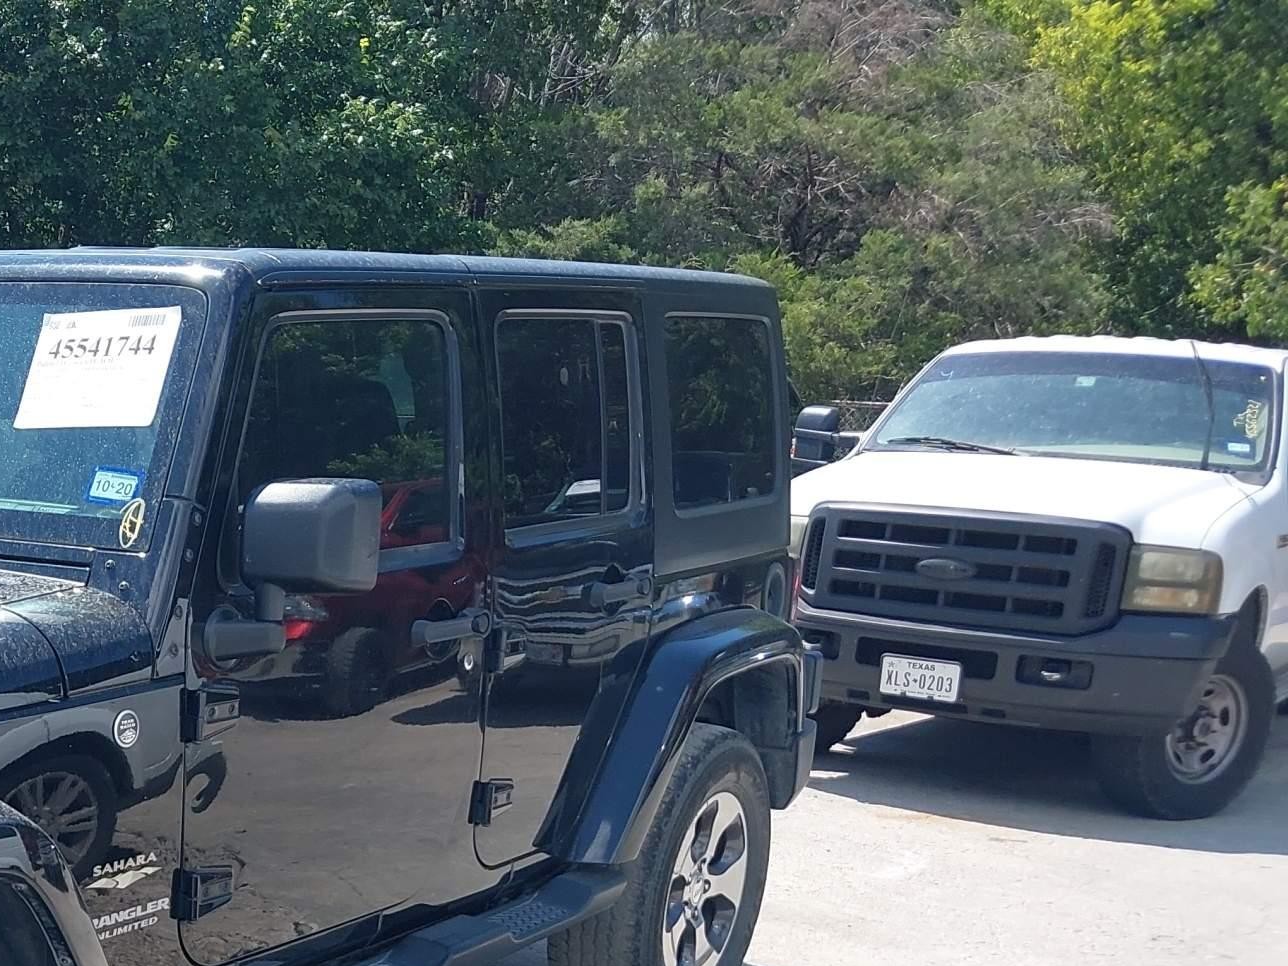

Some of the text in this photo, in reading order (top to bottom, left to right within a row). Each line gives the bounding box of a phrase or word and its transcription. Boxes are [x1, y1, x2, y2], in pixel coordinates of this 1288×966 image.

[48, 334, 157, 359] 45541744
[907, 661, 936, 672] TEXAS
[92, 851, 157, 877] SAHARA
[92, 897, 170, 930] RANGLER
[98, 915, 159, 941] NLIMITED
